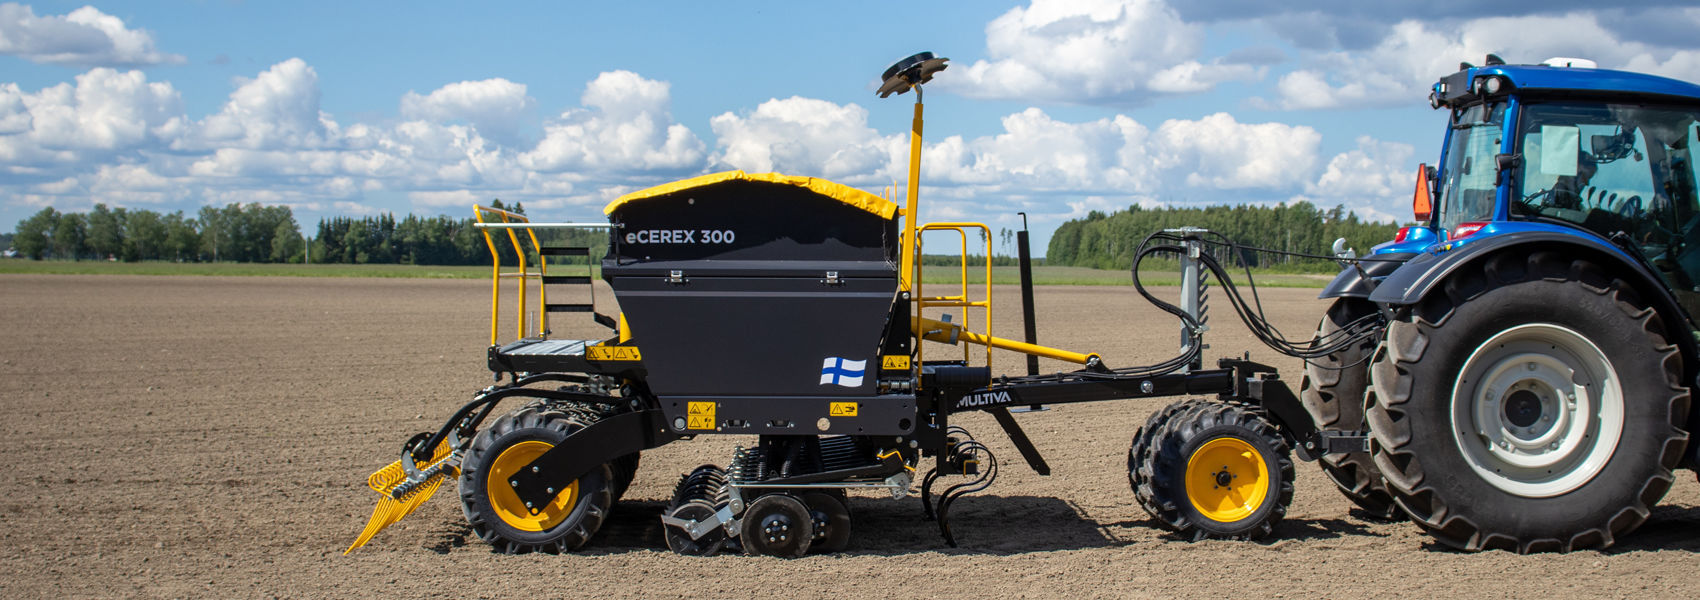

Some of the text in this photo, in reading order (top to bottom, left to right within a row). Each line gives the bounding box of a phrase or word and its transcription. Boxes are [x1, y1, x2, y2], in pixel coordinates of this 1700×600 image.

[626, 230, 735, 244] eCEREX 300
[956, 391, 1012, 408] MULTIVA
